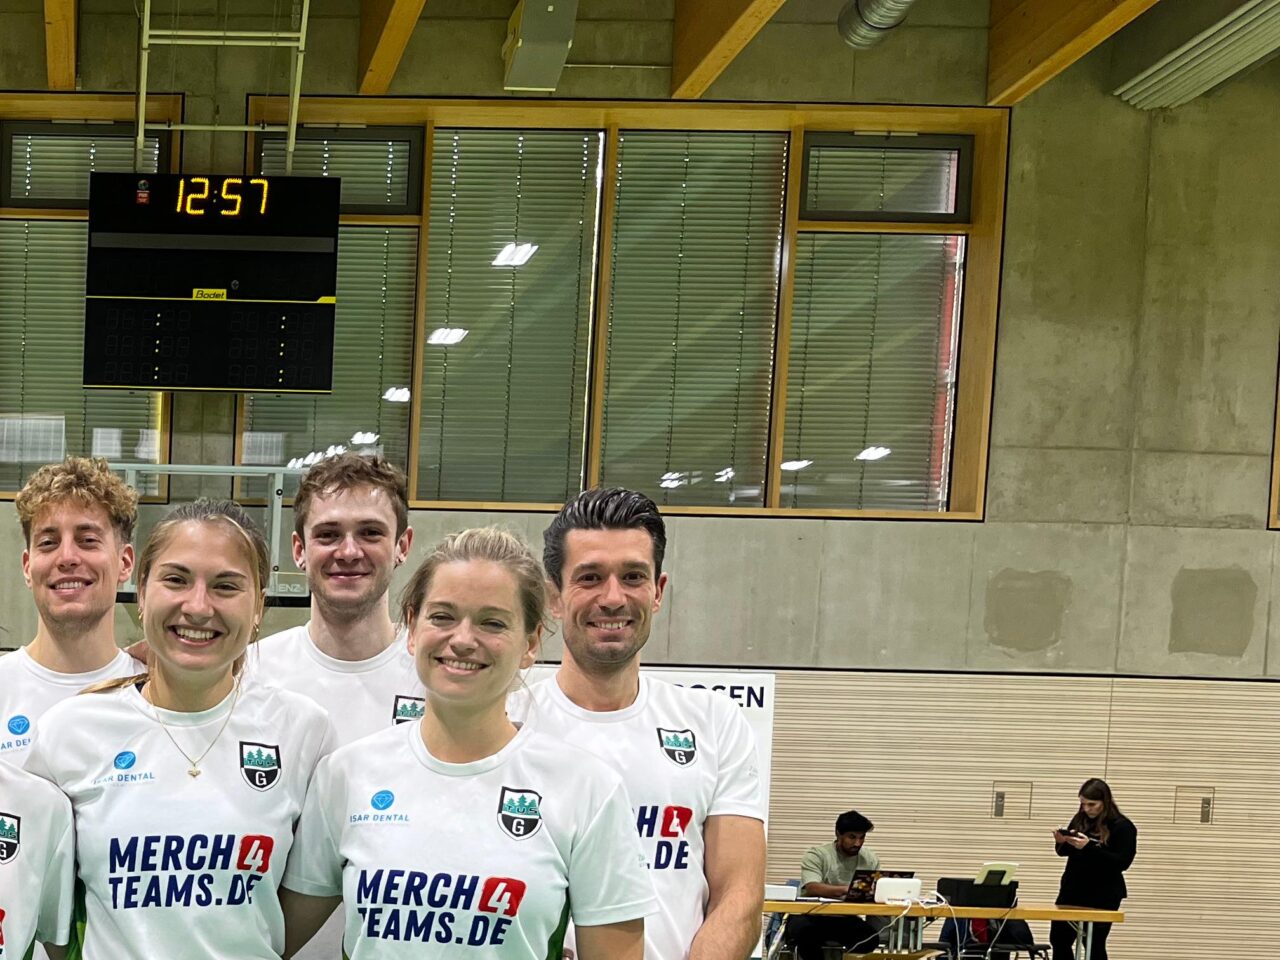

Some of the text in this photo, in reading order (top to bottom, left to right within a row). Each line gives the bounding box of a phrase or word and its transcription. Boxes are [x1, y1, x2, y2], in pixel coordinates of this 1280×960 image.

[176, 177, 269, 215] 12:57
[675, 750, 686, 764] G
[117, 772, 155, 782] DENTAL
[255, 771, 267, 786] G
[350, 814, 370, 822] ISAR
[511, 817, 525, 835] G
[108, 873, 263, 910] TEAMS.DE
[356, 907, 513, 947] TEAMS.DE
